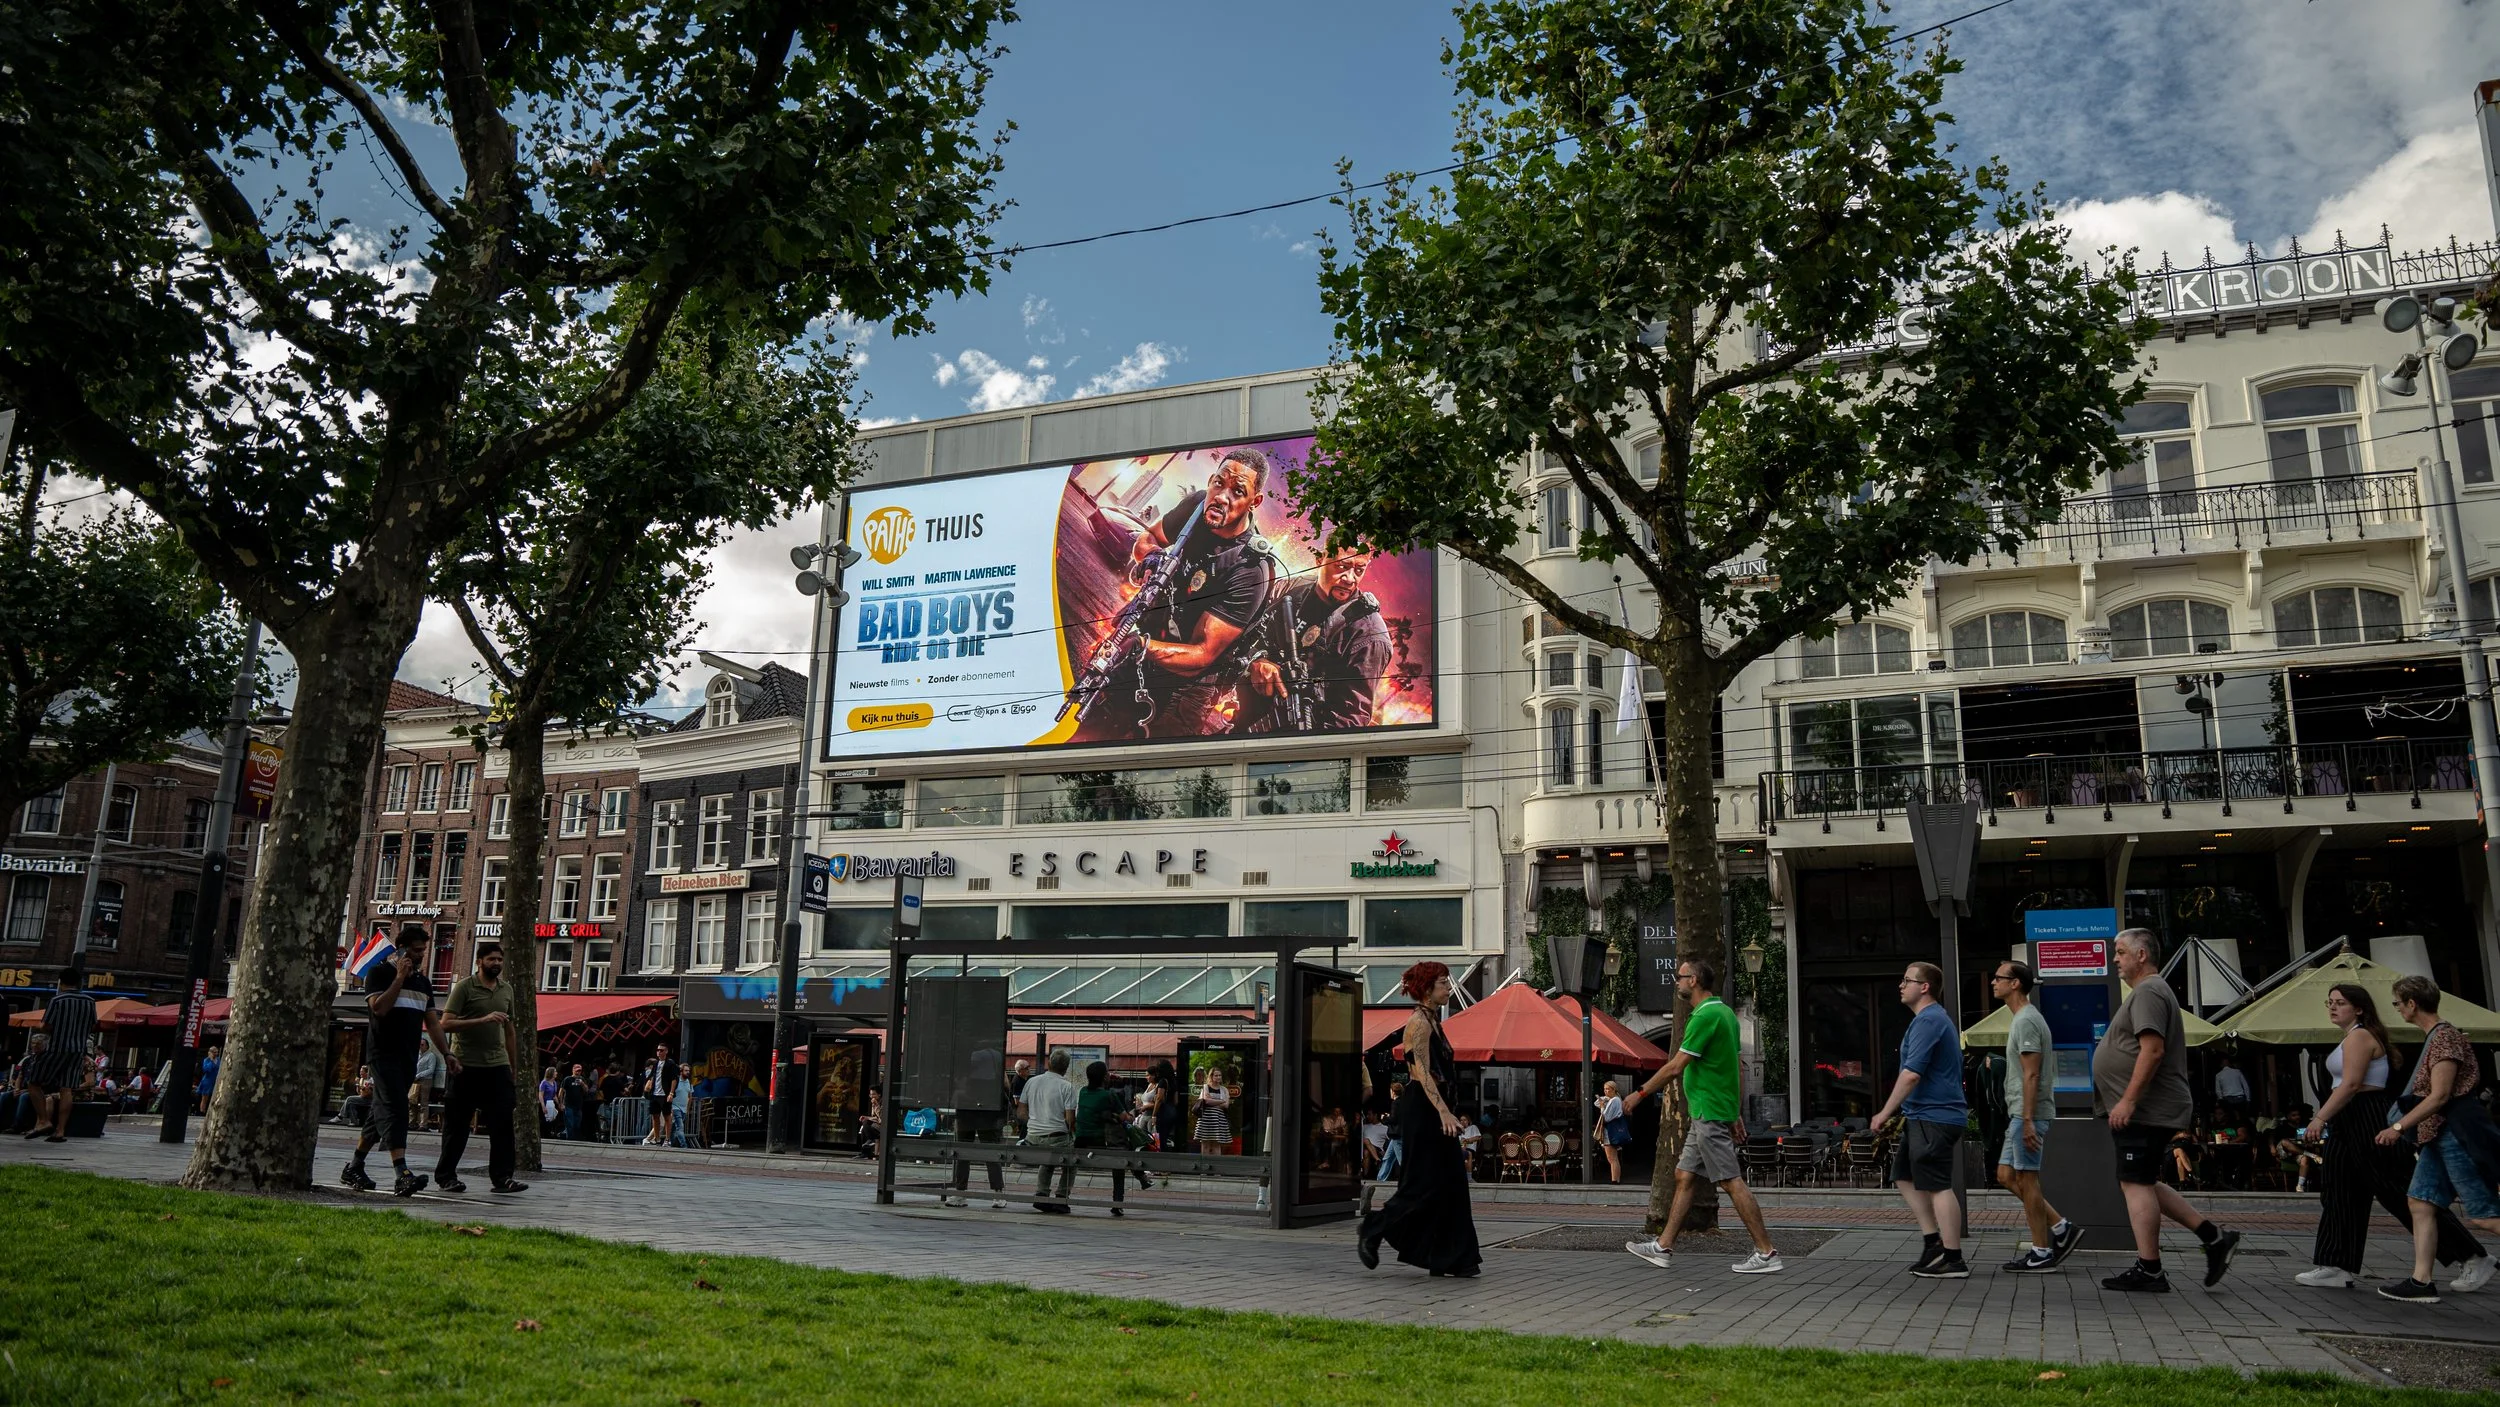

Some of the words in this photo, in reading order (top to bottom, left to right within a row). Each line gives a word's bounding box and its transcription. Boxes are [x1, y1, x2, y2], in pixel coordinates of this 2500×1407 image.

[2175, 251, 2388, 310] KROON
[925, 513, 984, 543] THUIS
[862, 580, 883, 591] WILL
[886, 575, 915, 589] SMITH
[924, 571, 961, 585] MARTIN
[964, 564, 1017, 581] LAWRENCE
[857, 599, 923, 643] BAD
[927, 590, 1015, 637] BOYS
[881, 641, 921, 664] RIDE
[926, 637, 950, 660] OR
[956, 635, 986, 658] DIE
[849, 679, 889, 690] Nieuwste
[890, 677, 909, 687] films
[928, 674, 959, 684] Zonder
[961, 670, 1015, 682] abonnement
[861, 714, 879, 725] Kijk
[881, 714, 894, 722] nu
[896, 711, 919, 722] thuis
[986, 708, 999, 716] kpn
[249, 751, 269, 764] Hard
[0, 853, 77, 874] Bavaria
[852, 850, 956, 882] Bavaria
[1009, 848, 1207, 876] ESCAPE
[1350, 860, 1437, 878] Heineken
[663, 873, 717, 891] Heineken
[718, 873, 745, 887] Bier
[377, 903, 395, 915] Café
[395, 904, 416, 915] Tante
[416, 903, 442, 918] Roosje
[475, 923, 503, 937] TITUS
[534, 923, 556, 937] ERIE
[559, 923, 569, 937] &
[571, 923, 600, 937] GRILL
[1643, 926, 1666, 937] DE
[2076, 925, 2089, 933] Bus
[1655, 958, 1678, 970] PRI
[0, 968, 33, 987] OS
[87, 972, 115, 988] pub
[726, 1104, 763, 1119] ESCAPE
